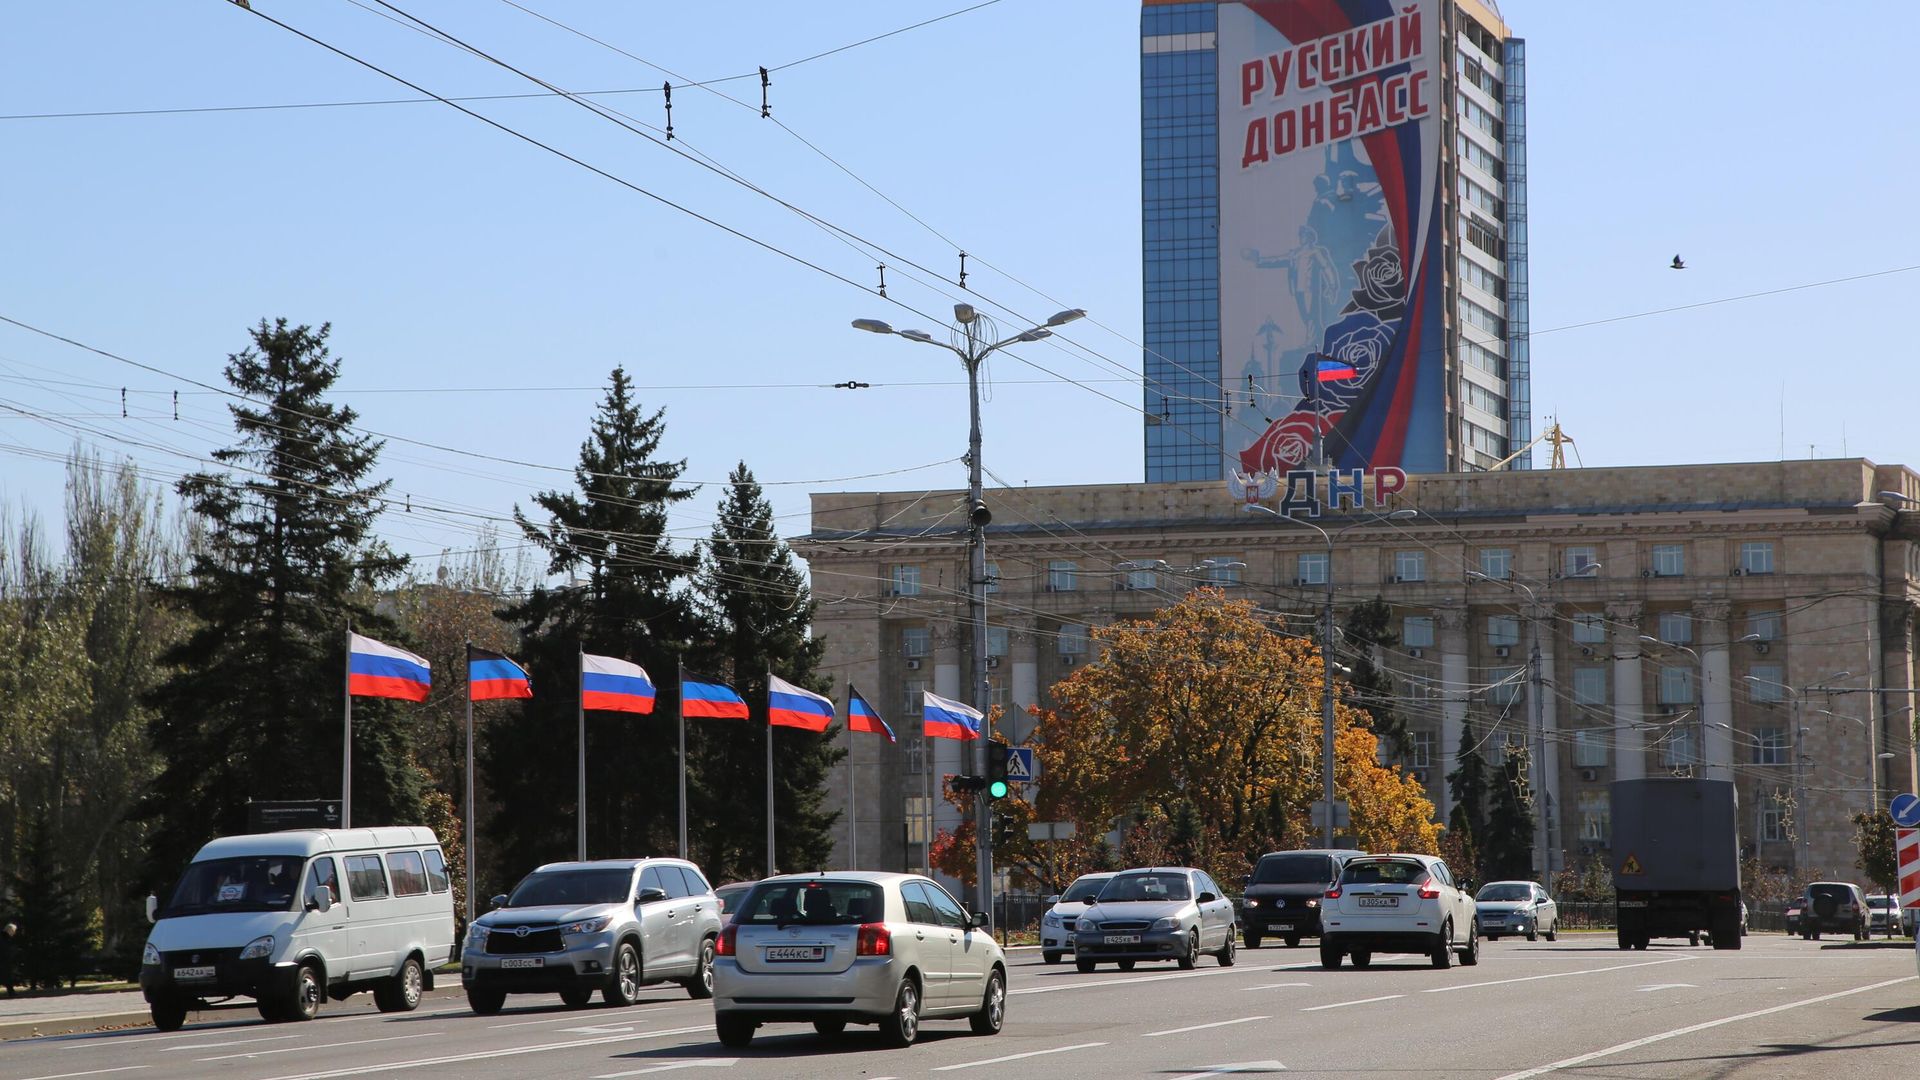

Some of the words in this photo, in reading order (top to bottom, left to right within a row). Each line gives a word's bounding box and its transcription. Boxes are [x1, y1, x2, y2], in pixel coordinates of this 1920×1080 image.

[1241, 3, 1422, 106] РУССКИЙ
[1241, 69, 1429, 169] ДОНБАСС
[1279, 466, 1408, 518] ДНР
[769, 949, 809, 959] Е444КС
